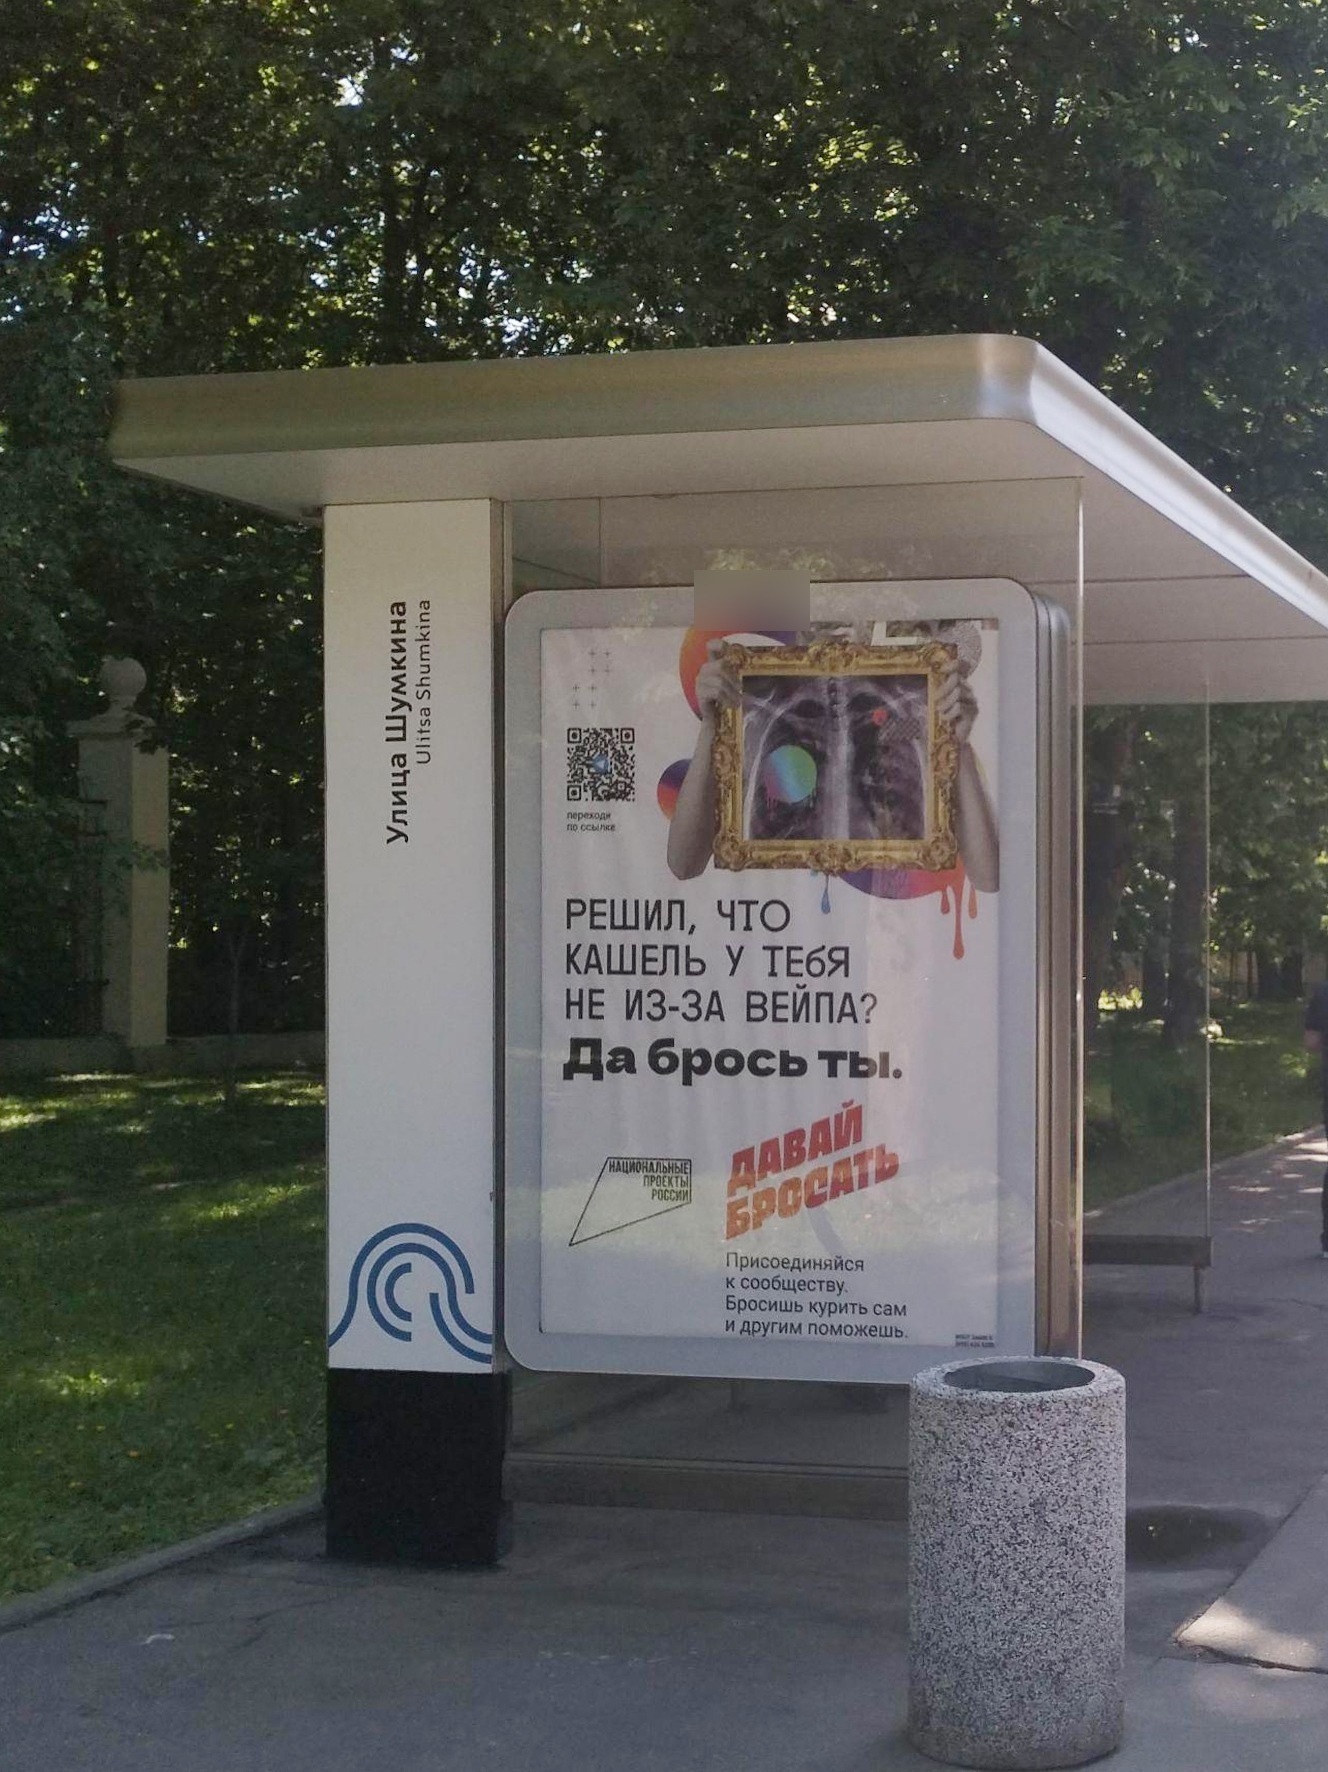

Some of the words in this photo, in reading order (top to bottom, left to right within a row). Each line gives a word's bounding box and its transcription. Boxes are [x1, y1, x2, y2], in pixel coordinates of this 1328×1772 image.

[415, 599, 432, 700] Shumkina
[385, 600, 412, 743] Шумкина
[416, 706, 432, 765] Ulitsa
[386, 753, 410, 845] Улица
[567, 811, 611, 822] переходи
[566, 898, 697, 935] РЕШИЛ,
[717, 899, 791, 932] ЧТО
[565, 943, 706, 976] КАШЕЛЬ
[725, 945, 744, 977] У
[565, 988, 605, 1020] НЕ
[625, 988, 725, 1023] ИЗ-ЗА
[746, 983, 878, 1024] ВЕЙПА?
[563, 1037, 637, 1081] Да
[648, 1038, 808, 1086] брось
[817, 1050, 903, 1079] ты.
[727, 1099, 863, 1197] ДАВАЙ
[608, 1160, 690, 1175] НАЦИОНАЛЬНЫЕ
[643, 1175, 689, 1188] ПРОЕКТЫ
[651, 1188, 690, 1201] РОССИИ
[726, 1143, 900, 1241] БРОСАТЬ
[726, 1252, 864, 1272] Присоединяйся
[726, 1277, 735, 1289] к
[740, 1276, 848, 1295] сообществу.
[726, 1295, 803, 1313] Бросишь
[808, 1299, 868, 1320] курить
[873, 1303, 907, 1317] сам
[726, 1320, 735, 1332] и
[739, 1319, 802, 1340] другим
[808, 1323, 909, 1339] поможешь.
